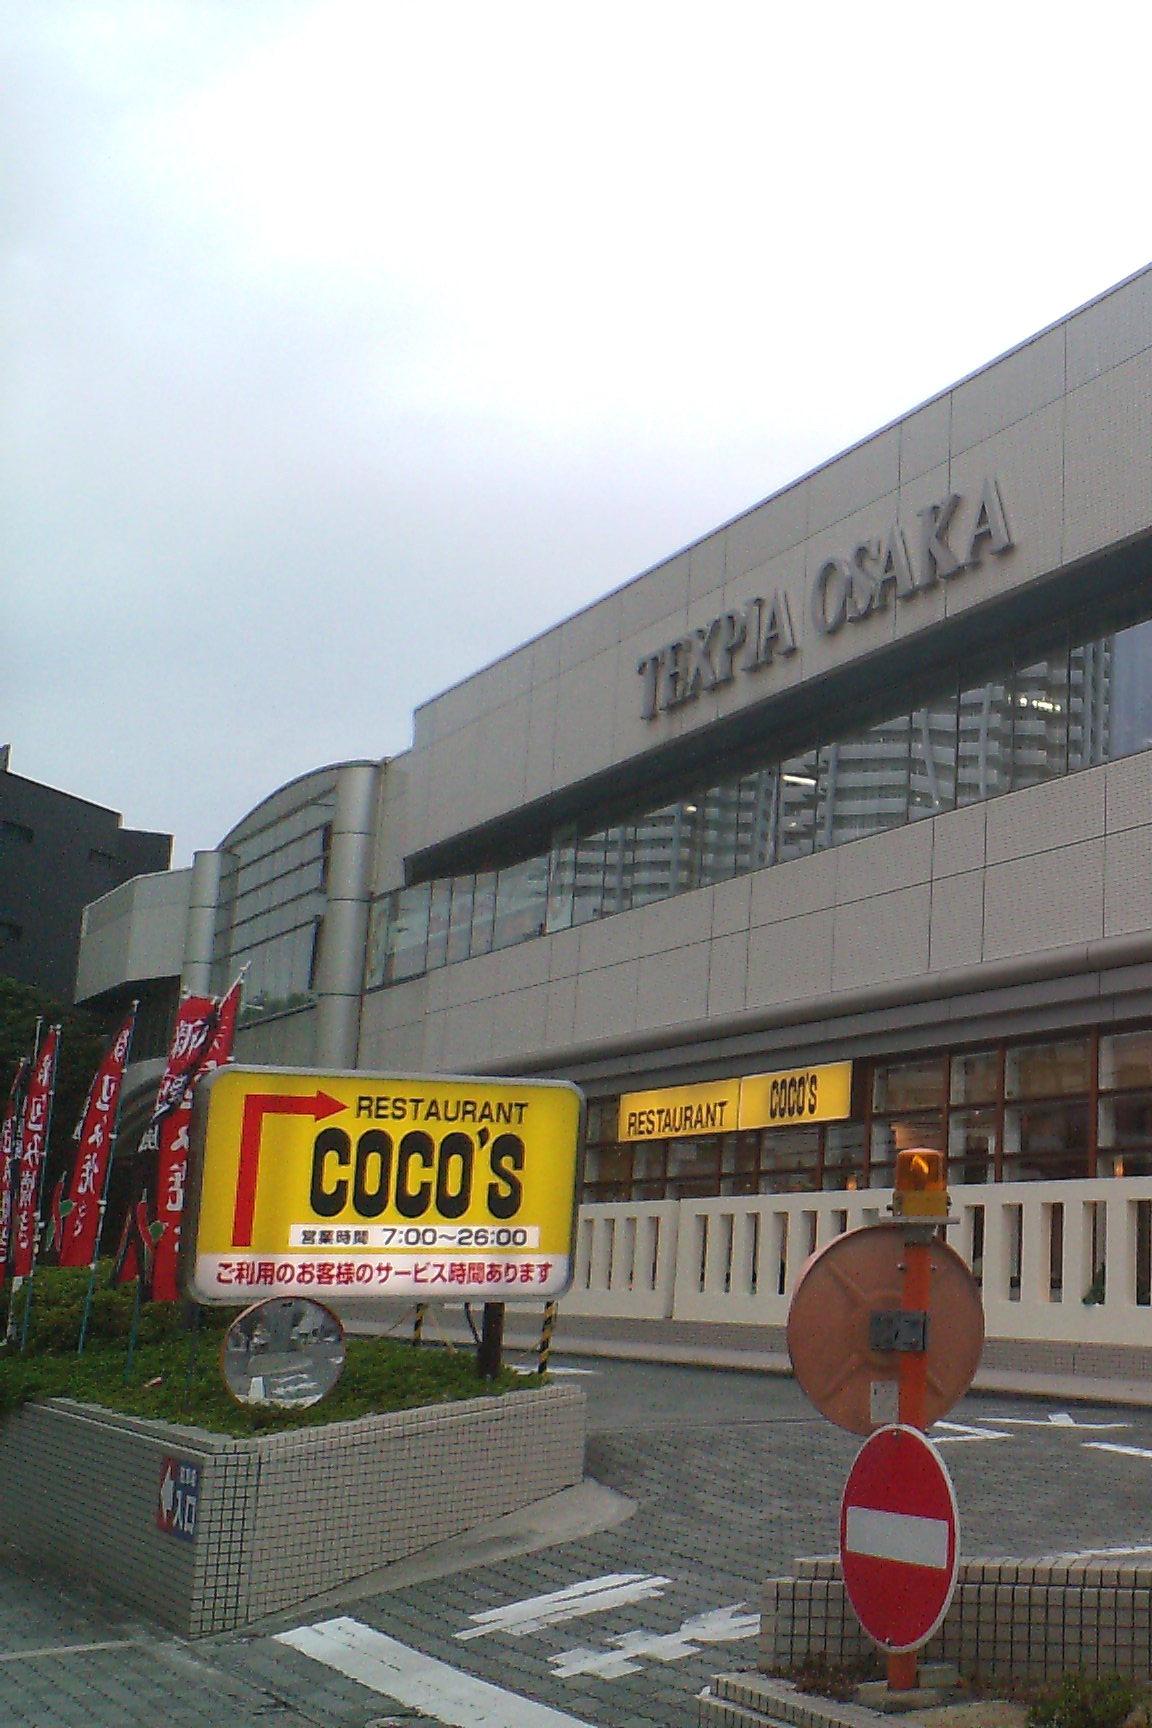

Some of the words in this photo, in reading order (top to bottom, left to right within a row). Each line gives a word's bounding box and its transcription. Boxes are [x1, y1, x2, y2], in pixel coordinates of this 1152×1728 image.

[637, 587, 798, 721] TEXPIA
[812, 477, 1015, 635] OSAKA
[355, 1095, 529, 1125] RESTAURANT
[628, 1101, 728, 1137] RESTAURANT
[769, 1073, 819, 1119] COCO'S
[309, 1126, 527, 1220] COCO'S
[301, 1229, 369, 1245] 営業時間
[215, 1261, 554, 1287] ご利用のお客様のサービス時間あります
[172, 1490, 197, 1536] 入口
